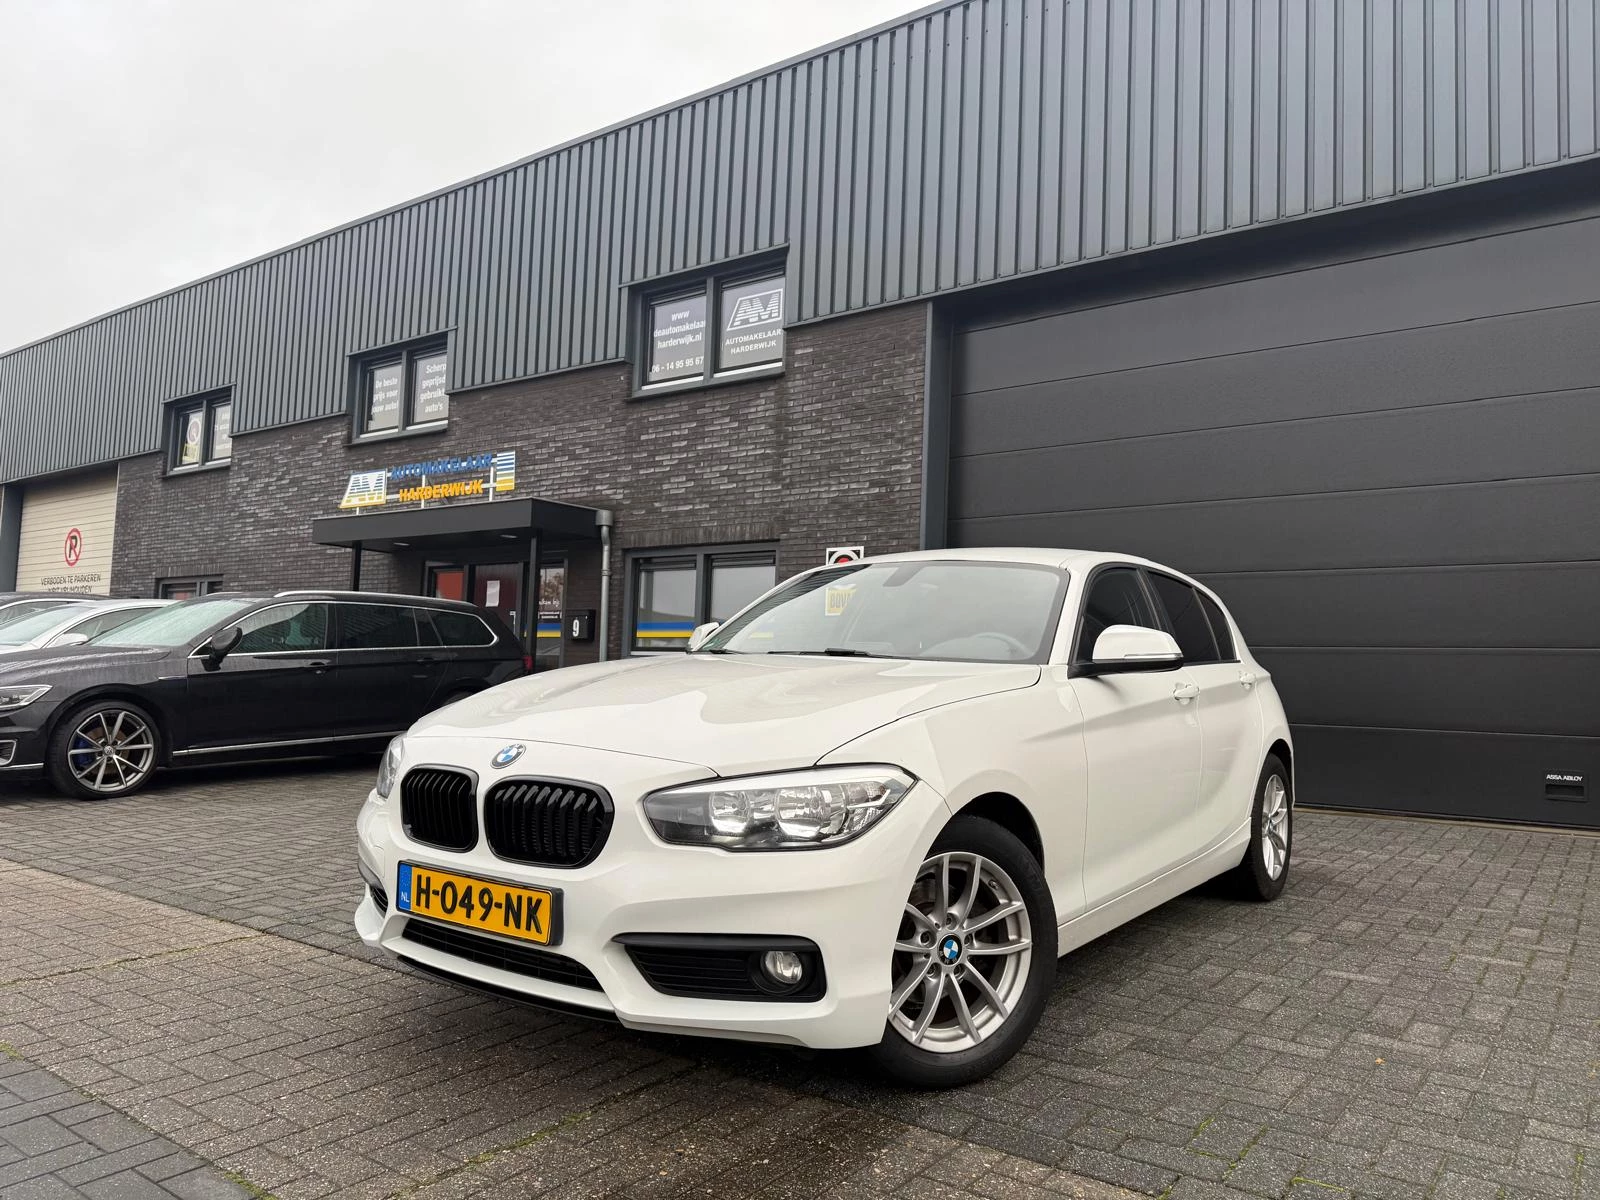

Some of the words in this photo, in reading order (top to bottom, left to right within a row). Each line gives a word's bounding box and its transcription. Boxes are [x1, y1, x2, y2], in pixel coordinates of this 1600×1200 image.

[657, 332, 702, 348] harderwijk.nl
[730, 339, 777, 354] HARDERWIJK
[651, 364, 660, 373] 06
[666, 362, 674, 371] 14
[675, 360, 684, 369] 95
[685, 358, 694, 367] 95
[424, 401, 444, 413] auto's
[390, 453, 493, 481] AUTOMAKELAAR
[399, 478, 484, 502] HARDERWIJK
[41, 575, 67, 586] VERBODEN
[67, 574, 74, 584] TE
[74, 573, 101, 584] PARKEREN
[572, 619, 580, 637] 9
[401, 891, 409, 903] NL
[415, 874, 543, 934] H-049-NK
